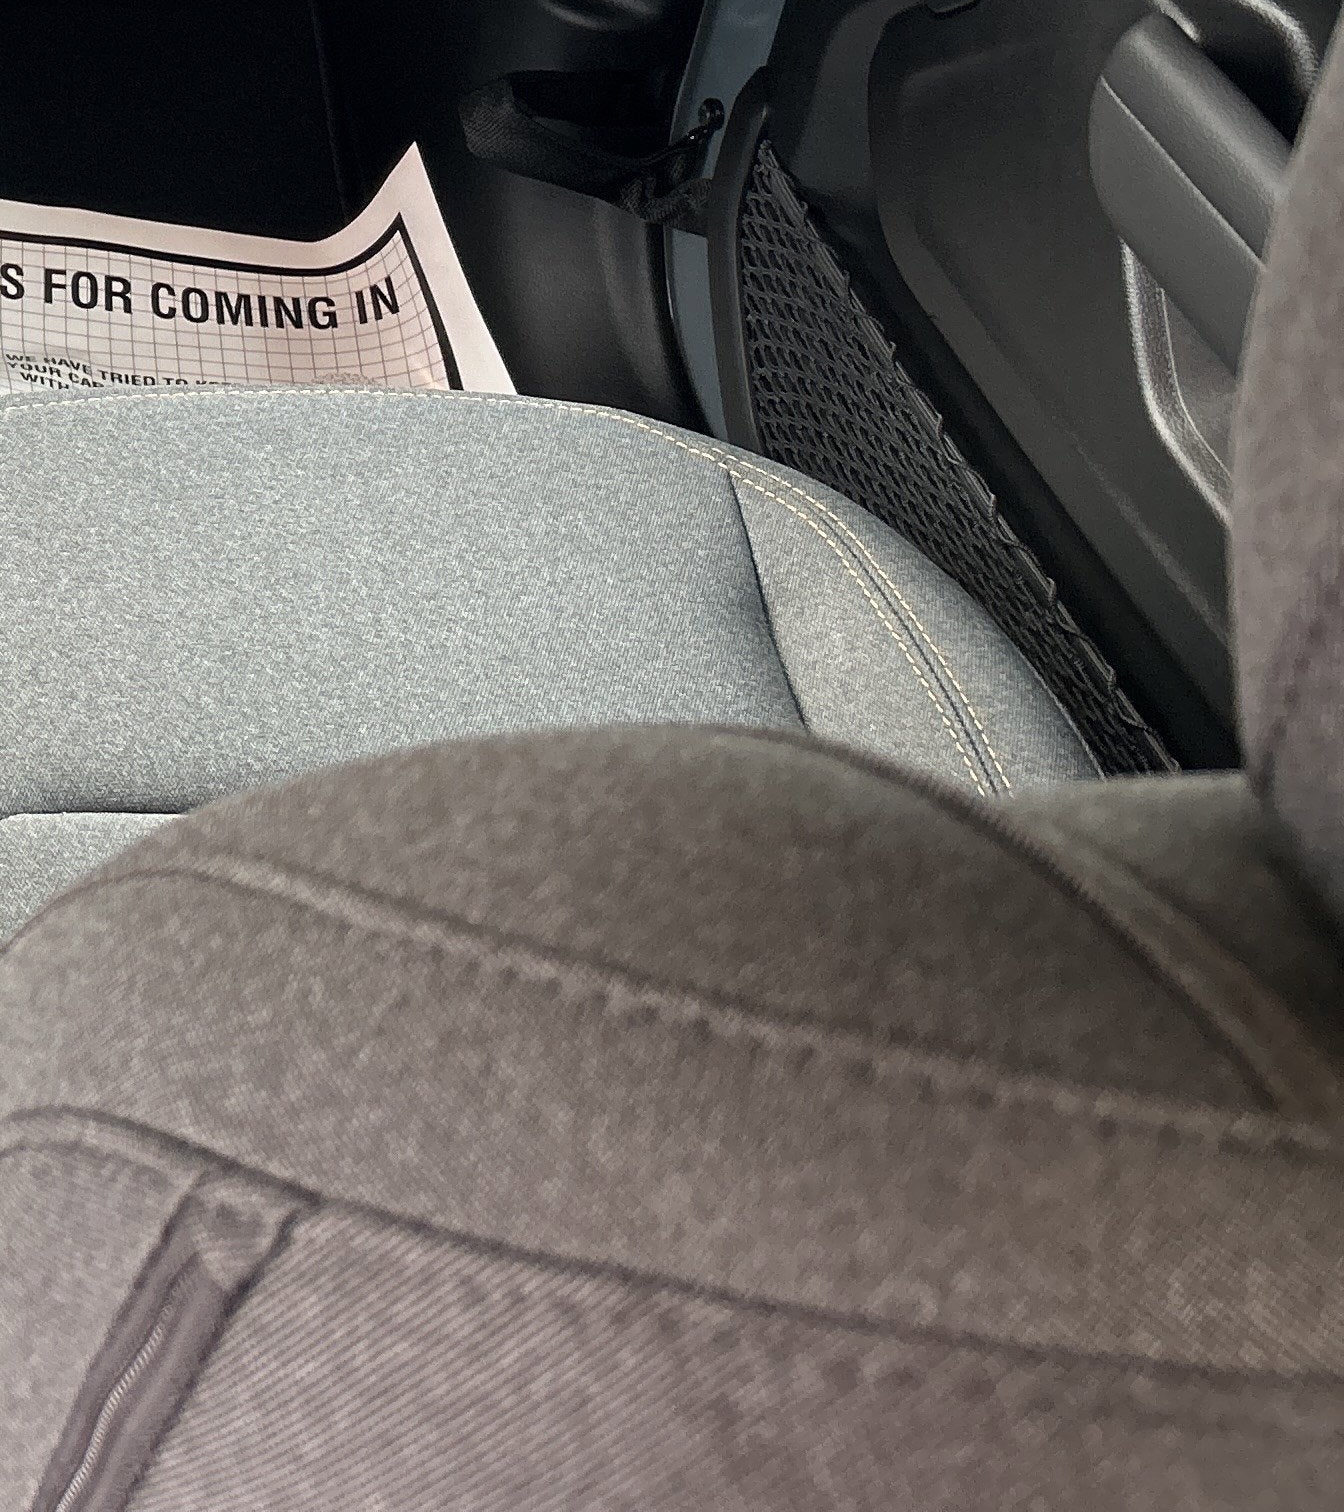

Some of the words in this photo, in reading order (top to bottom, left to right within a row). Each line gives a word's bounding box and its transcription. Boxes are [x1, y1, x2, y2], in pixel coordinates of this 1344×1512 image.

[44, 268, 133, 314] FOR
[151, 279, 338, 330] COMING
[354, 276, 400, 325] IN
[6, 354, 37, 362] WE
[44, 357, 91, 374] HAVE
[98, 370, 156, 385] TRIED
[7, 362, 62, 378] YOUR
